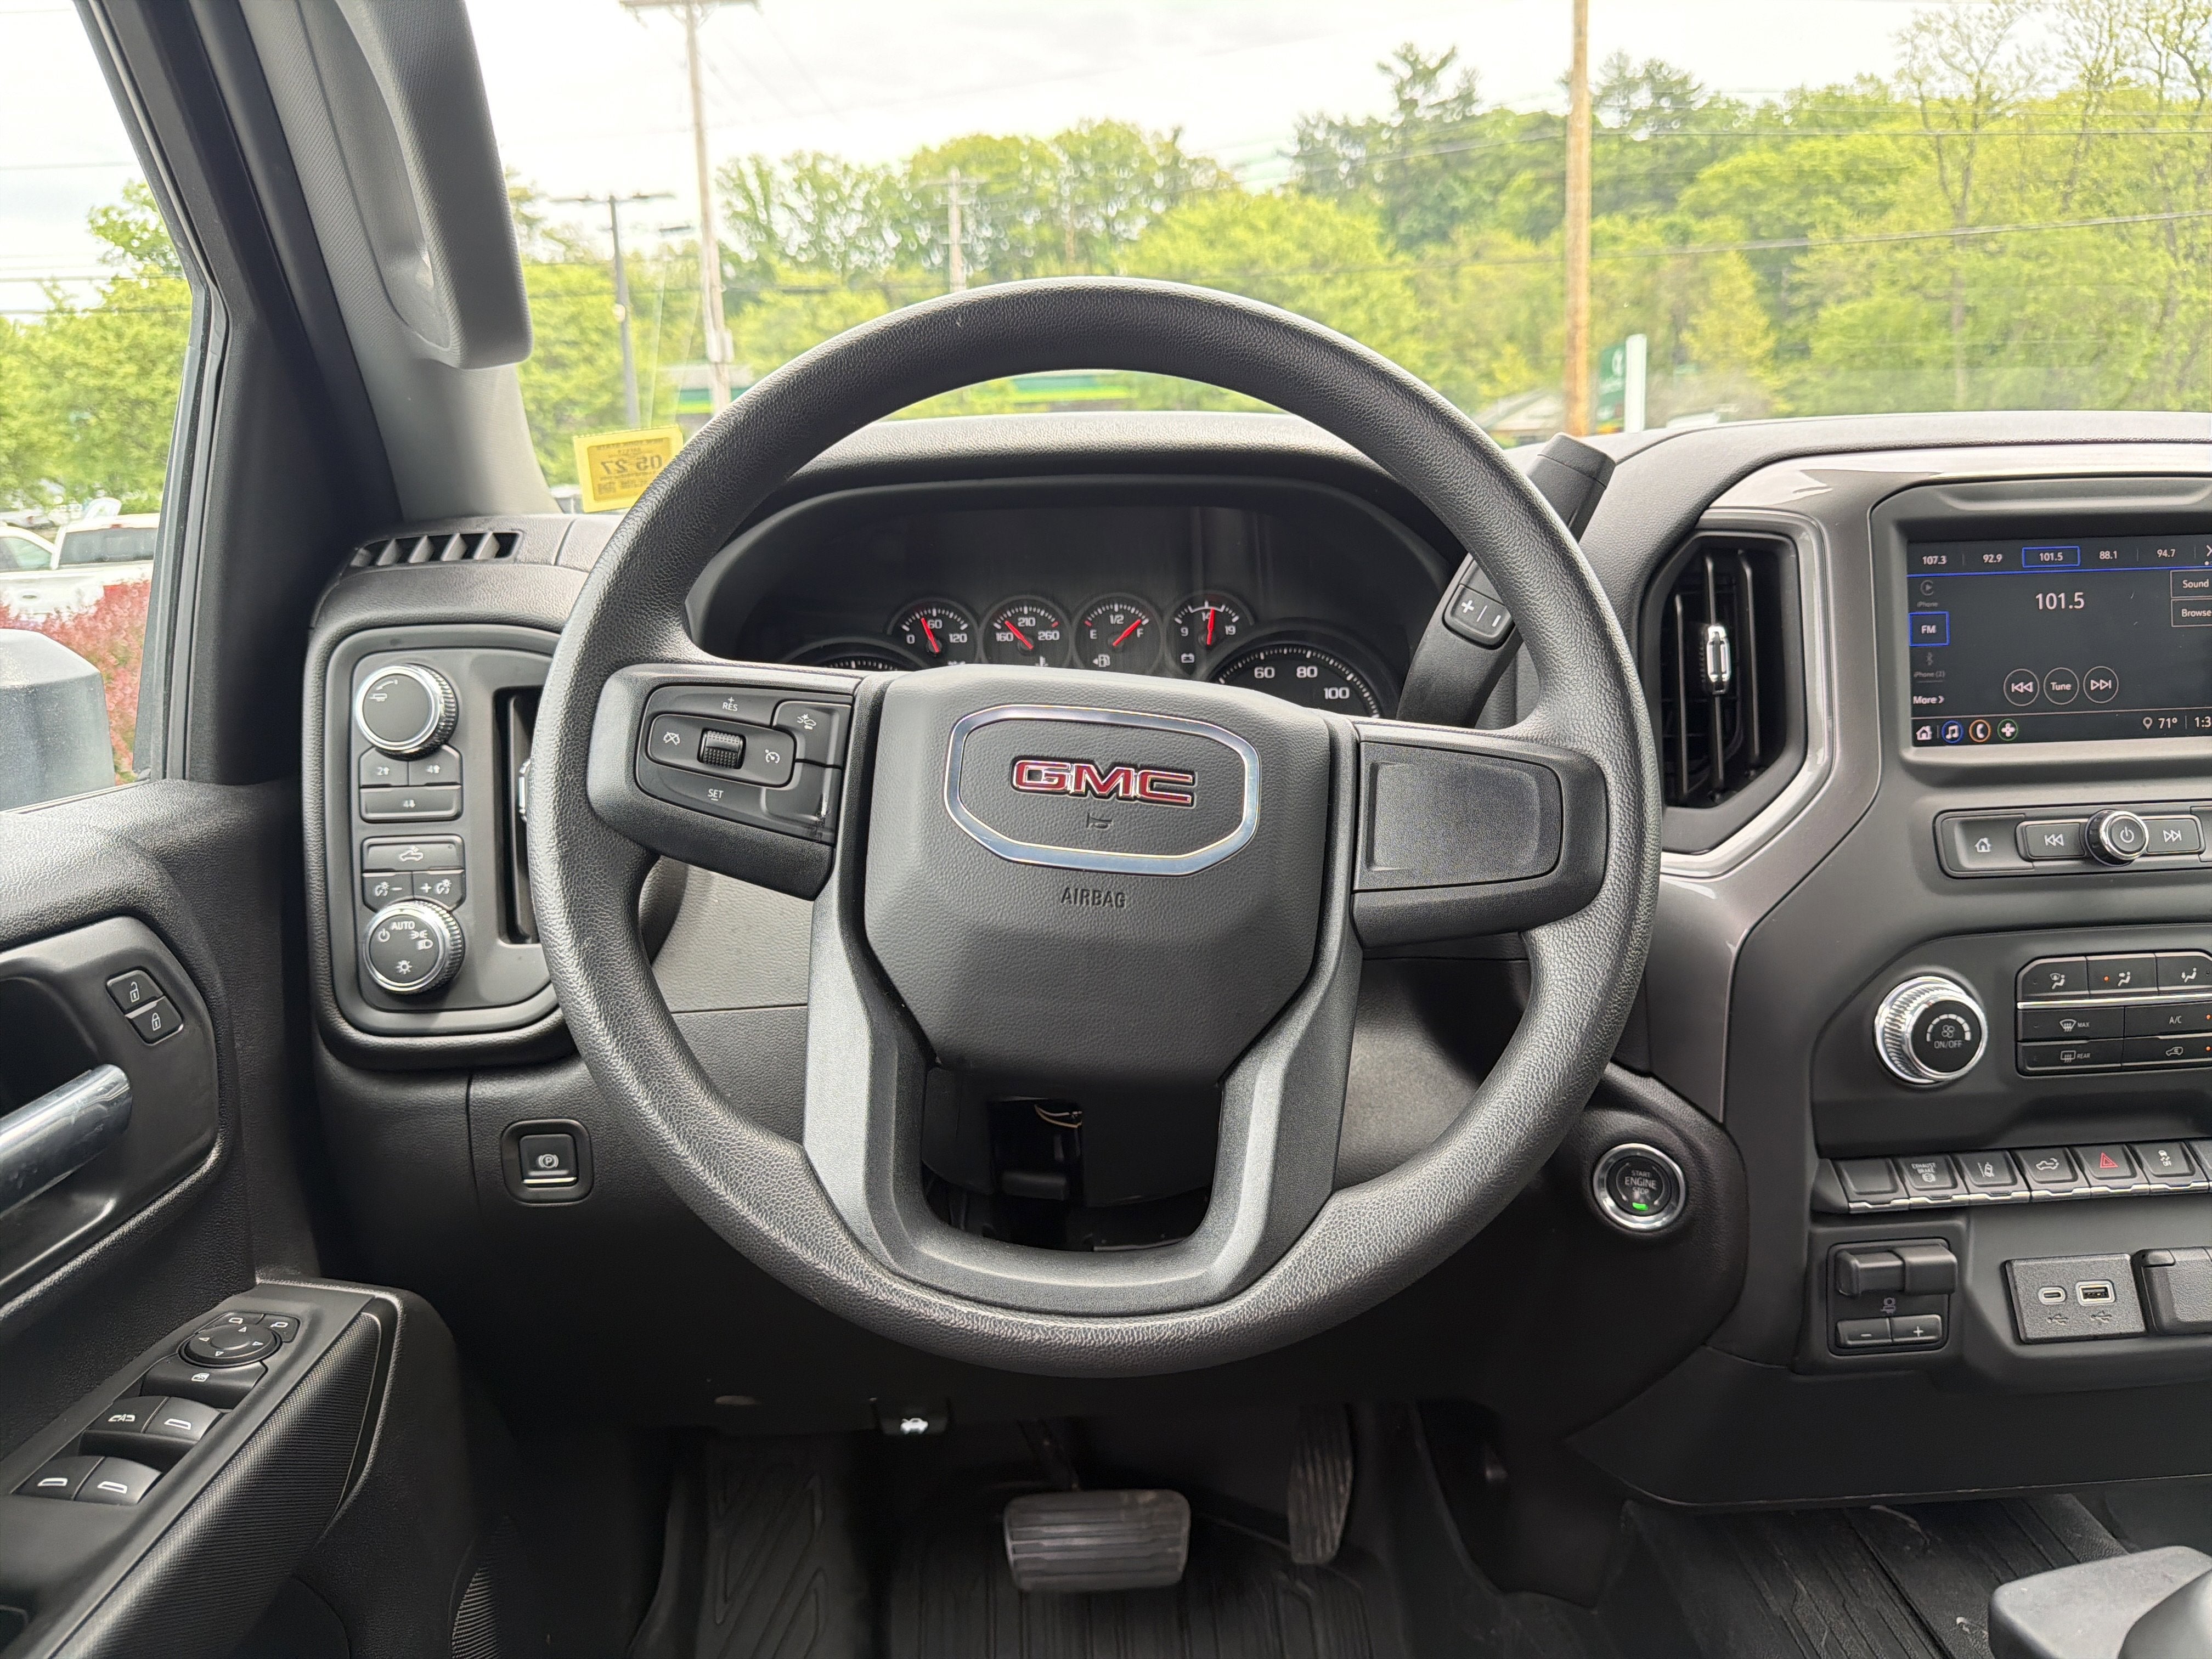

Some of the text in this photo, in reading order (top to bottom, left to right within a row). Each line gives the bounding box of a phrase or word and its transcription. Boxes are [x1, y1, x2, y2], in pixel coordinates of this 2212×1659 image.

[1983, 554, 2003, 563] 92.9
[2039, 552, 2063, 562] 101.5
[2099, 550, 2118, 560] 88.1
[2157, 549, 2176, 558] 94.7
[1922, 555, 1947, 565] 107.3
[2182, 579, 2209, 588] Sound
[2035, 592, 2085, 610] 101.5
[2181, 608, 2212, 617] Browse
[927, 619, 943, 629] 60
[1017, 617, 1036, 627] 210
[1109, 614, 1124, 624] 1/2
[1090, 629, 1097, 639] E
[1136, 628, 1144, 638] F
[1180, 627, 1189, 637] 9
[1224, 625, 1237, 635] 19
[1921, 625, 1937, 634] FM
[906, 634, 916, 644] 0
[949, 633, 968, 643] 120
[996, 632, 1014, 642] 160
[1037, 630, 1060, 641] 260
[1254, 666, 1276, 679] 60
[1296, 665, 1318, 679] 80
[2050, 682, 2072, 691] Tune
[1323, 687, 1350, 699] 100
[1913, 696, 1937, 704] More
[722, 702, 738, 712] RES
[2194, 716, 2212, 728] 1:3
[1014, 759, 1195, 806] GMC
[707, 788, 724, 798] SET
[1060, 887, 1127, 909] AIRBAG
[391, 921, 415, 931] AUTO
[2169, 1015, 2182, 1024] A/C
[1934, 1040, 1963, 1049] ON/OFF
[1631, 1170, 1651, 1178] START
[1624, 1176, 1657, 1190] ENGINE
